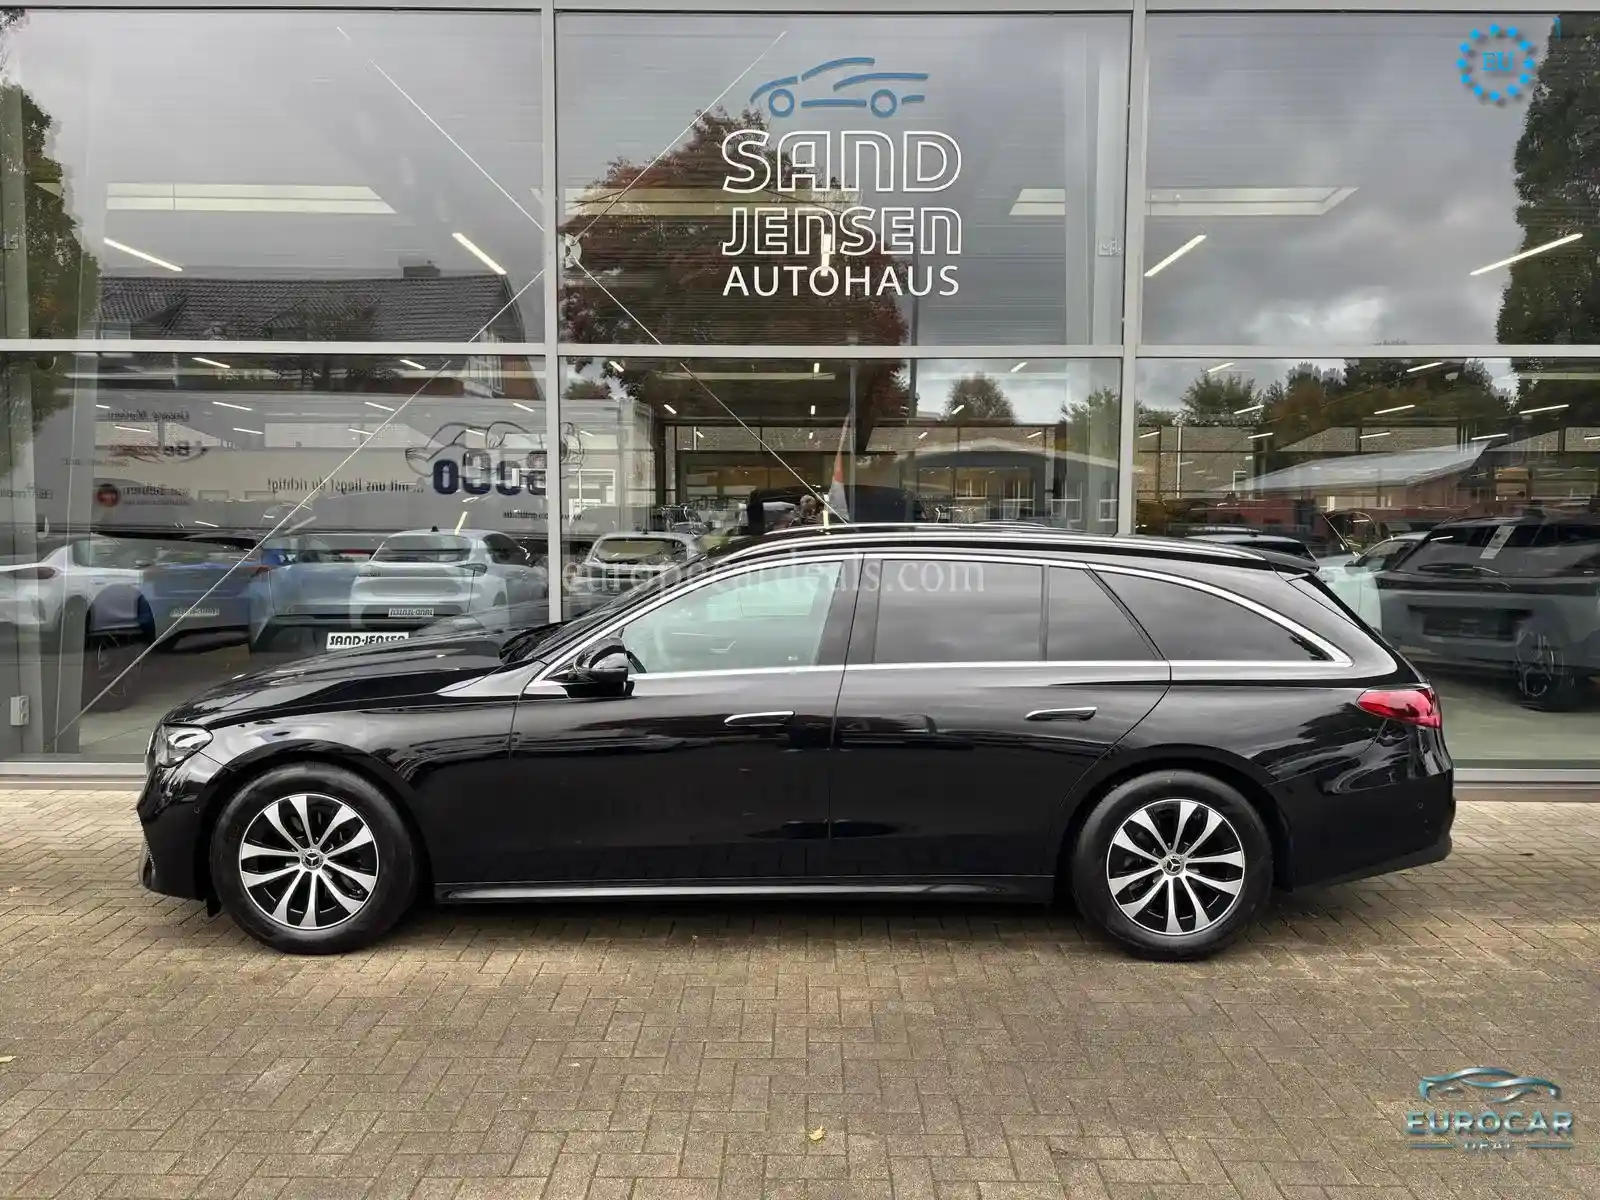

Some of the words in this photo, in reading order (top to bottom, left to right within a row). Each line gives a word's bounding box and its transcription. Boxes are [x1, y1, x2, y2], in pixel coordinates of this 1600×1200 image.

[721, 129, 962, 193] SAND
[721, 207, 962, 256] JENSEN
[722, 265, 960, 297] AUTOHAUS
